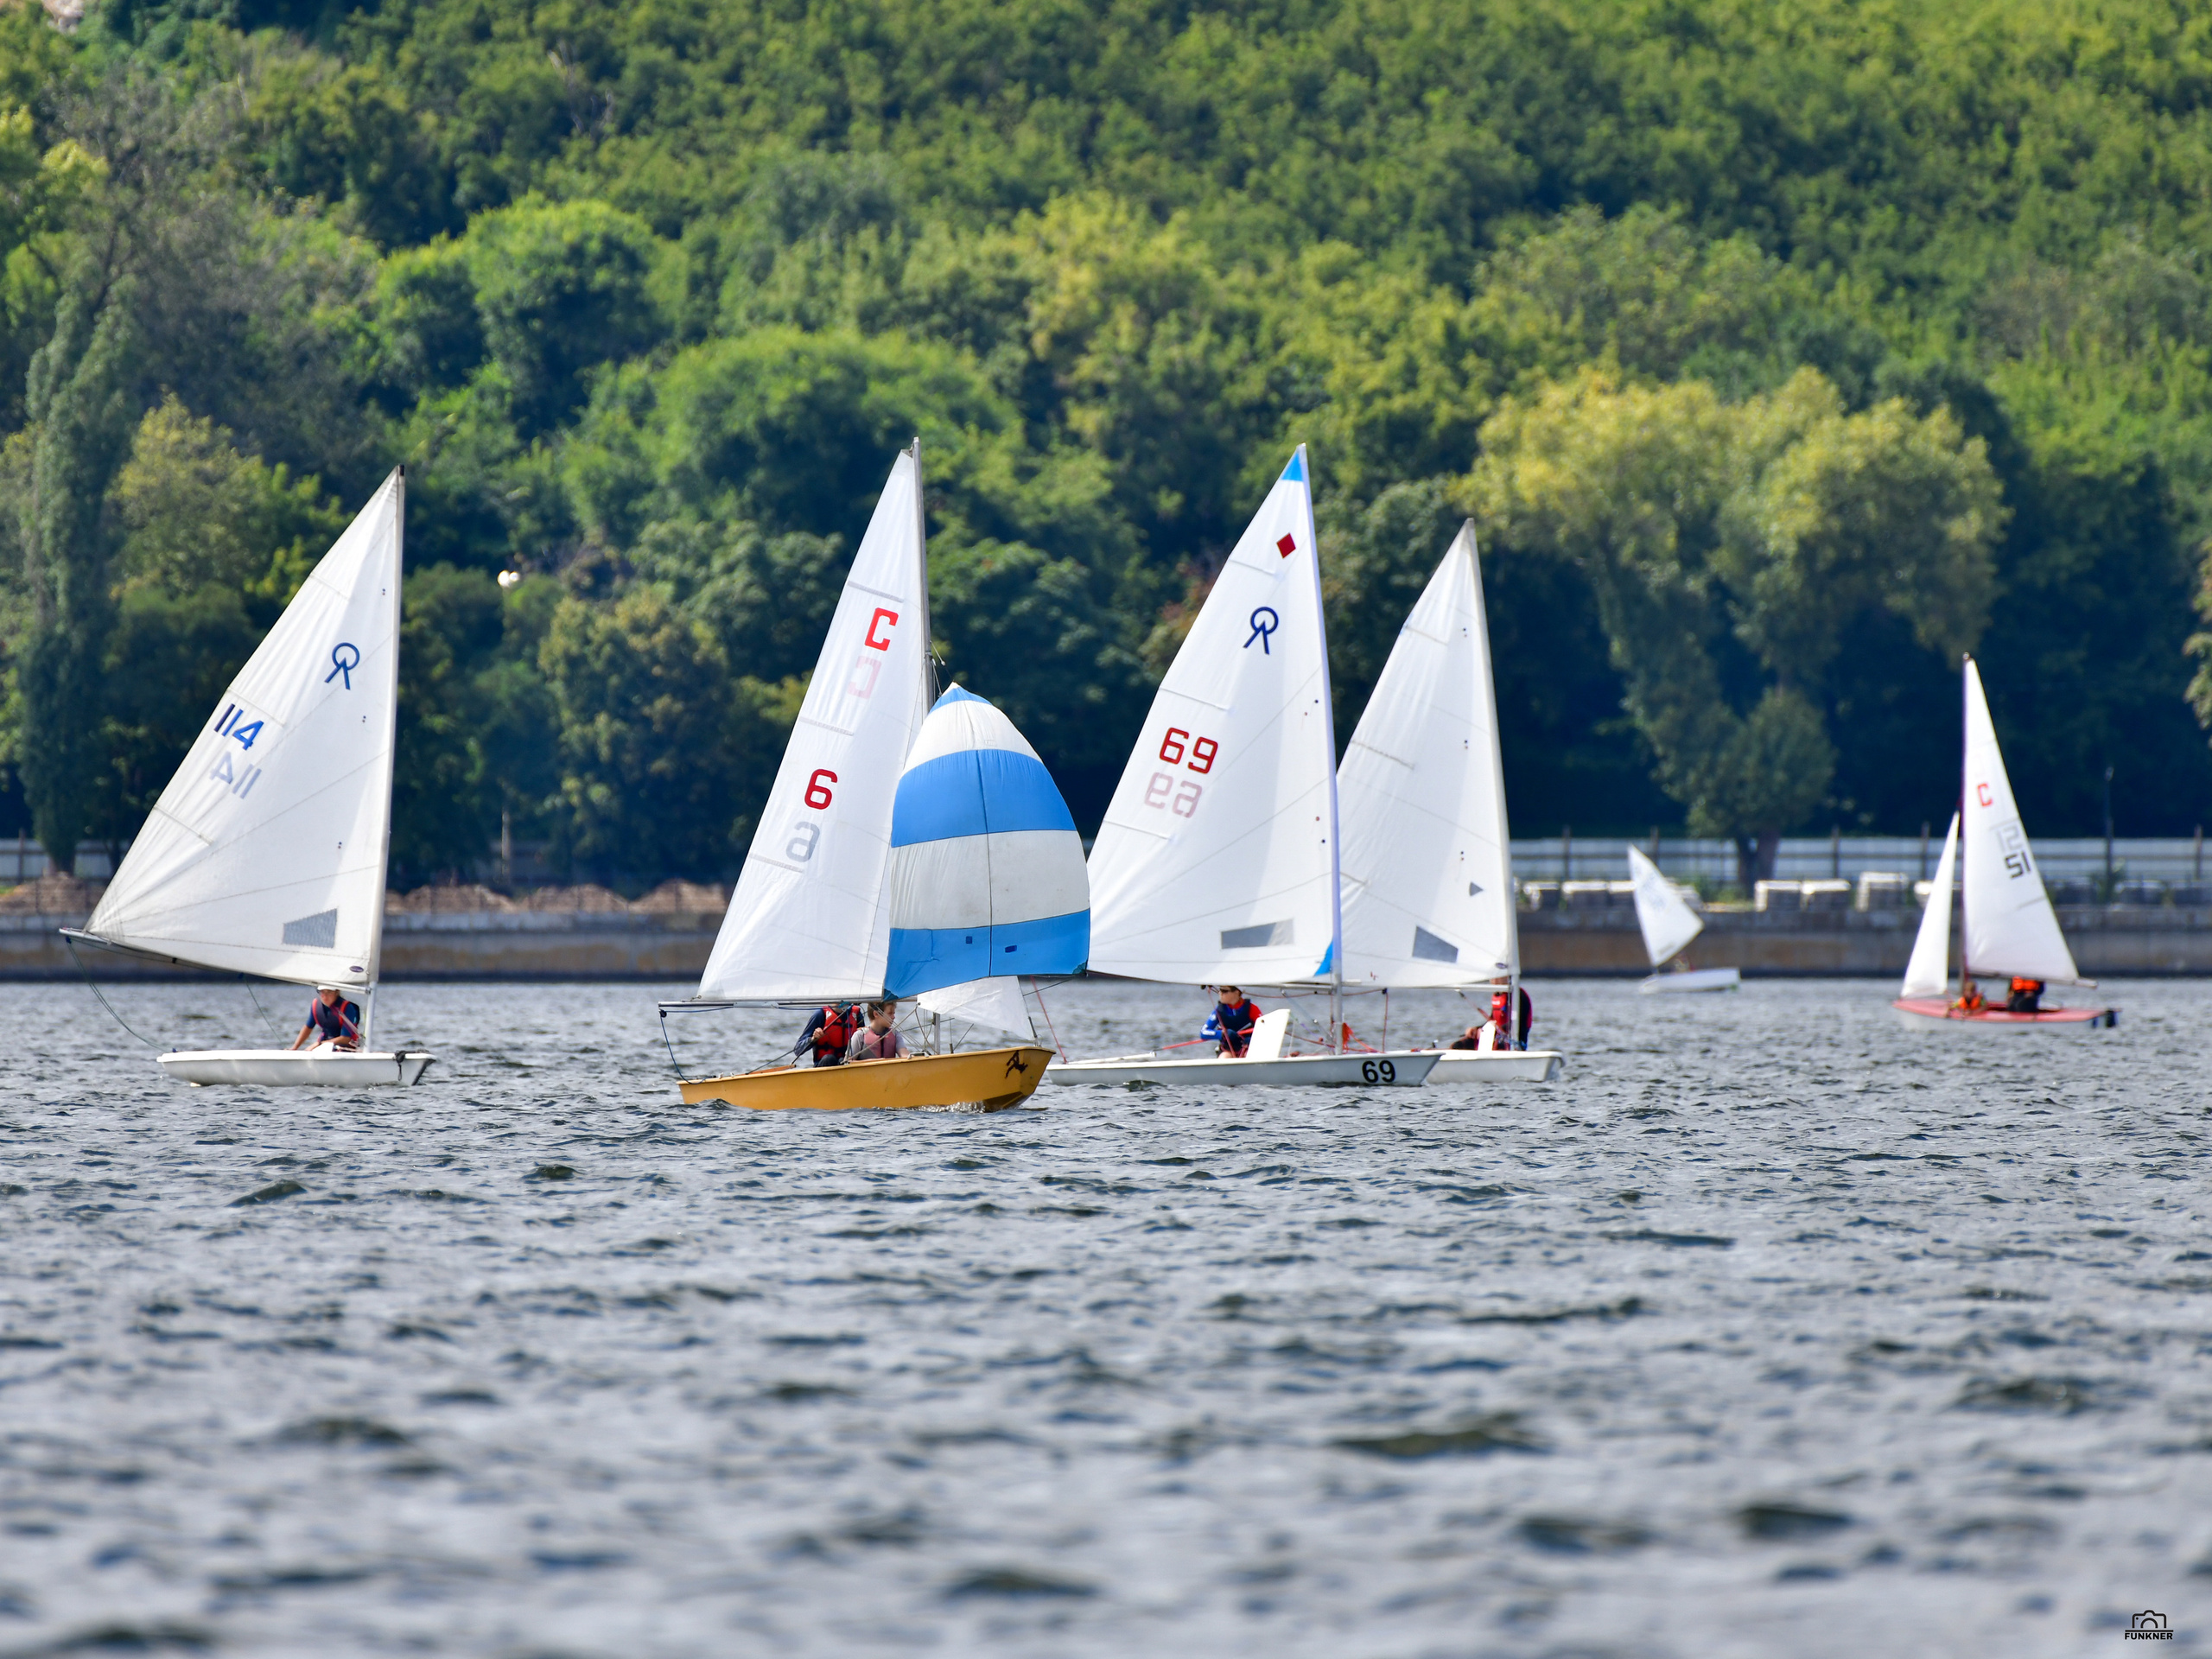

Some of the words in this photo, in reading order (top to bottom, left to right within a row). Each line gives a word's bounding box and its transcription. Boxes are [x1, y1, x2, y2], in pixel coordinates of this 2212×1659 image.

[864, 607, 899, 652] C
[213, 702, 264, 751] 114
[1159, 727, 1218, 774] 69
[804, 768, 838, 810] 6
[1977, 783, 1993, 808] C
[2005, 850, 2031, 880] 51
[1362, 1059, 1396, 1084] 69
